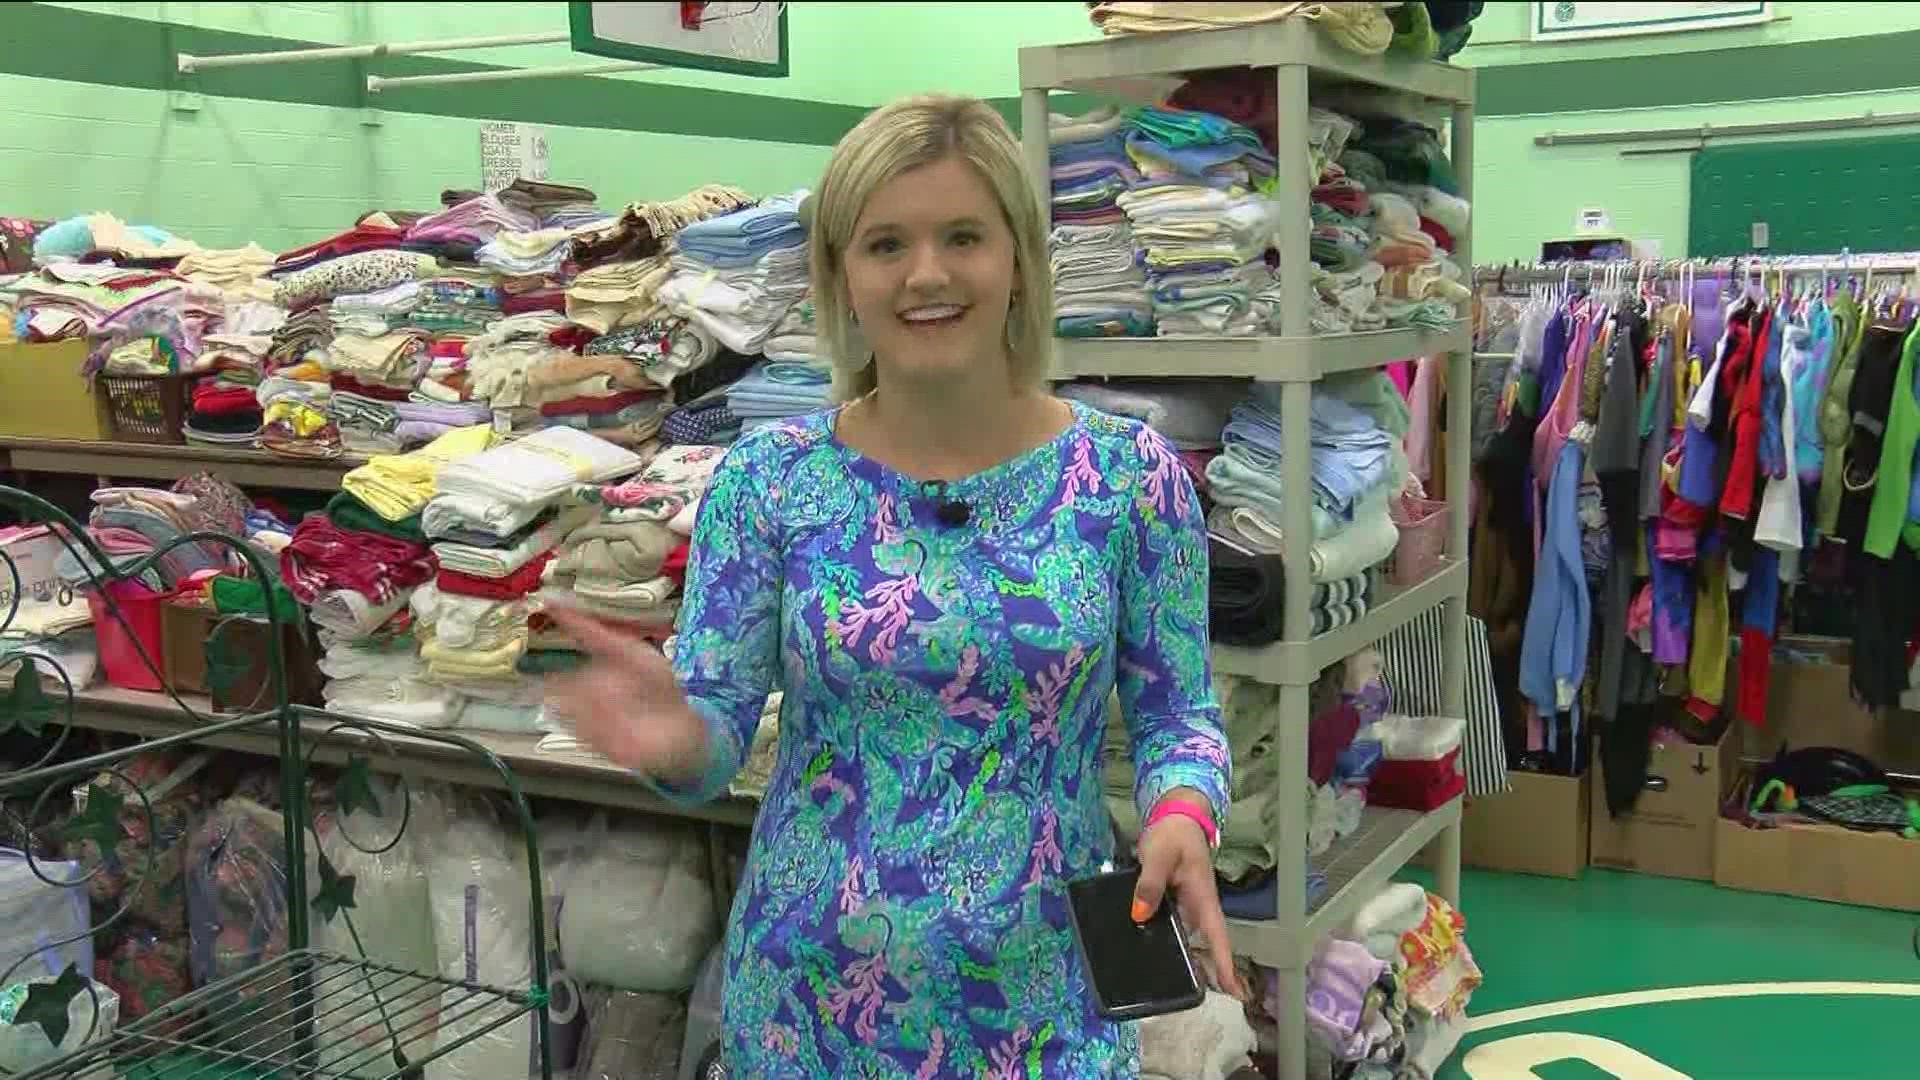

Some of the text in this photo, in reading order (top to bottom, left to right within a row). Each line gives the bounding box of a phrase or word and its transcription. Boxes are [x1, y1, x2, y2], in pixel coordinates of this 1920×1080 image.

[481, 123, 516, 134] WOMEN
[481, 133, 521, 145] BLOUSES
[481, 145, 512, 156] COATS
[481, 157, 522, 168] DRESSES
